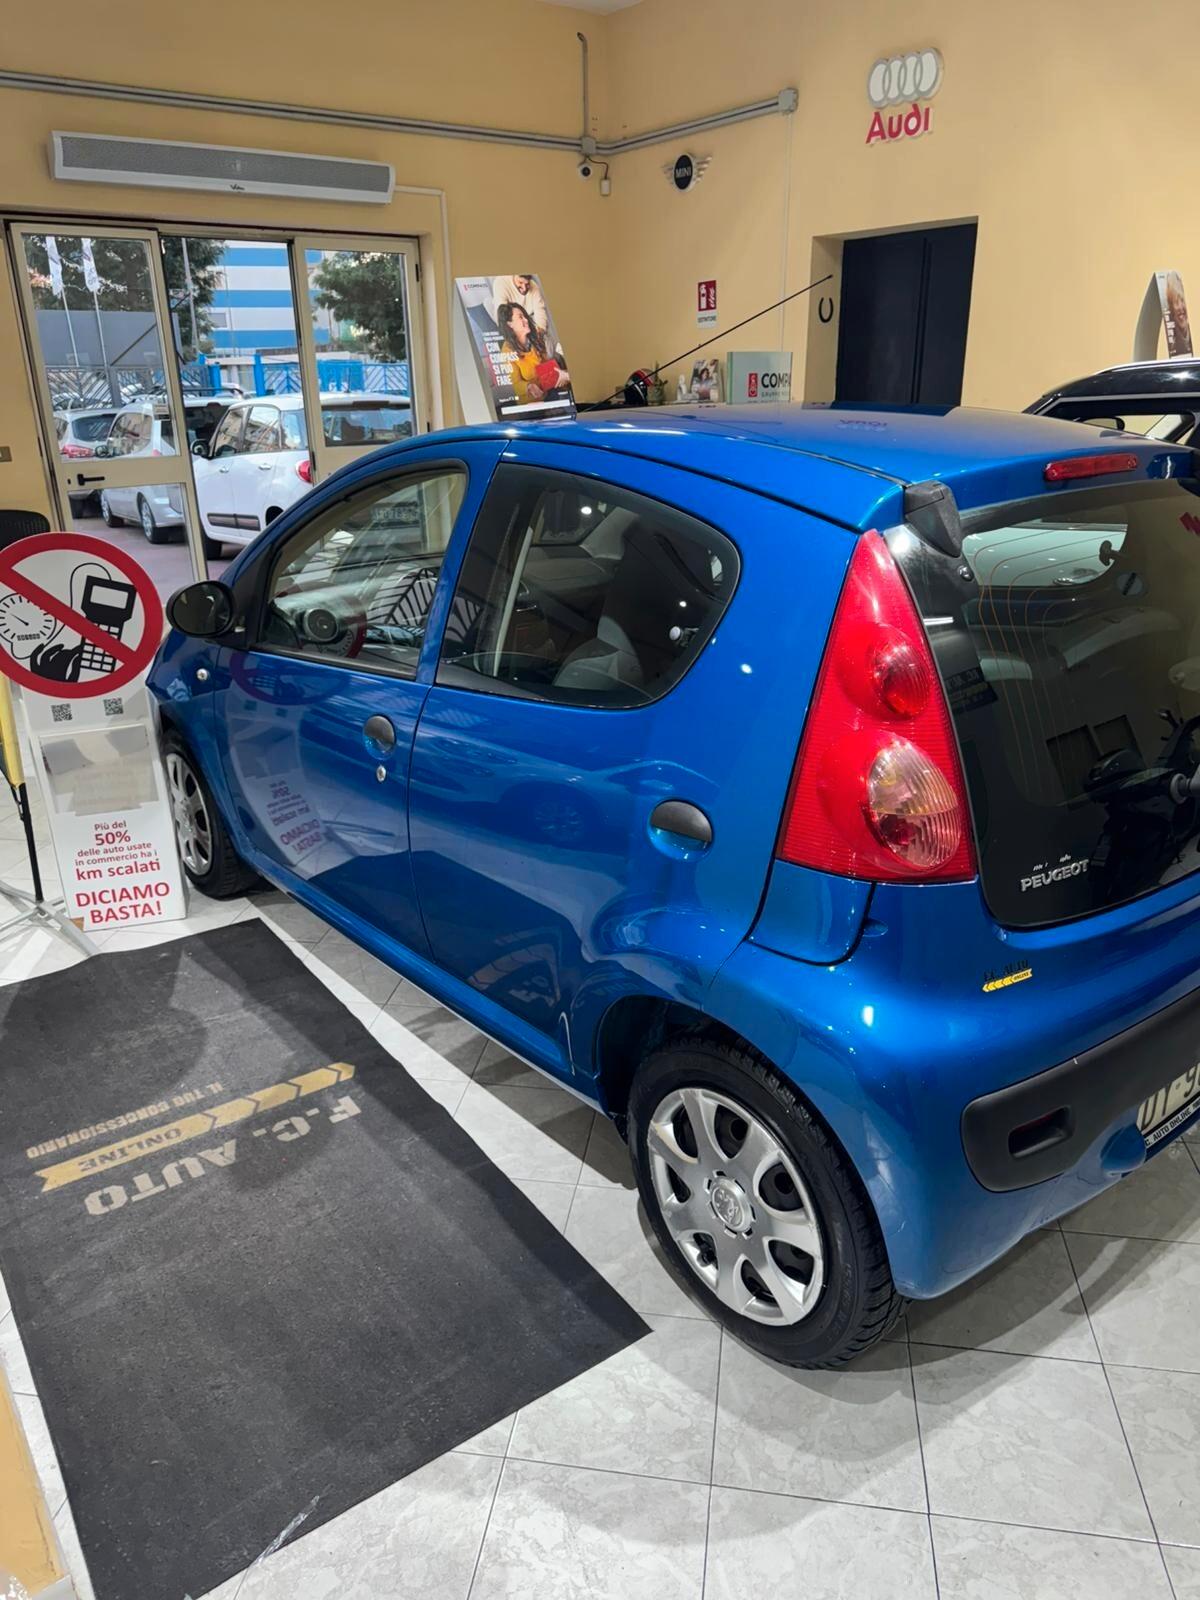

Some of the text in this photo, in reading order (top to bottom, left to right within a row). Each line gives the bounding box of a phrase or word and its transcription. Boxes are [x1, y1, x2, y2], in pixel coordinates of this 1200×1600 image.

[675, 166, 692, 178] MINI
[489, 352, 519, 364] COMPASS
[94, 820, 127, 831] Più del
[94, 830, 131, 846] 50%
[77, 842, 152, 858] delle auto usate
[86, 852, 138, 865] commercio
[140, 850, 152, 858] ha
[76, 858, 161, 881] km scalati
[1020, 859, 1089, 892] PEUGEOT
[75, 882, 170, 908] DICIAMO
[90, 901, 162, 924] BASTA!
[26, 1082, 224, 1160] IL TUO CONCESSIONARIO
[1153, 1126, 1170, 1141] AUTO
[1170, 1109, 1192, 1129] ONLINE
[78, 1126, 183, 1173] ONLINE
[84, 1138, 237, 1216] AUTO
